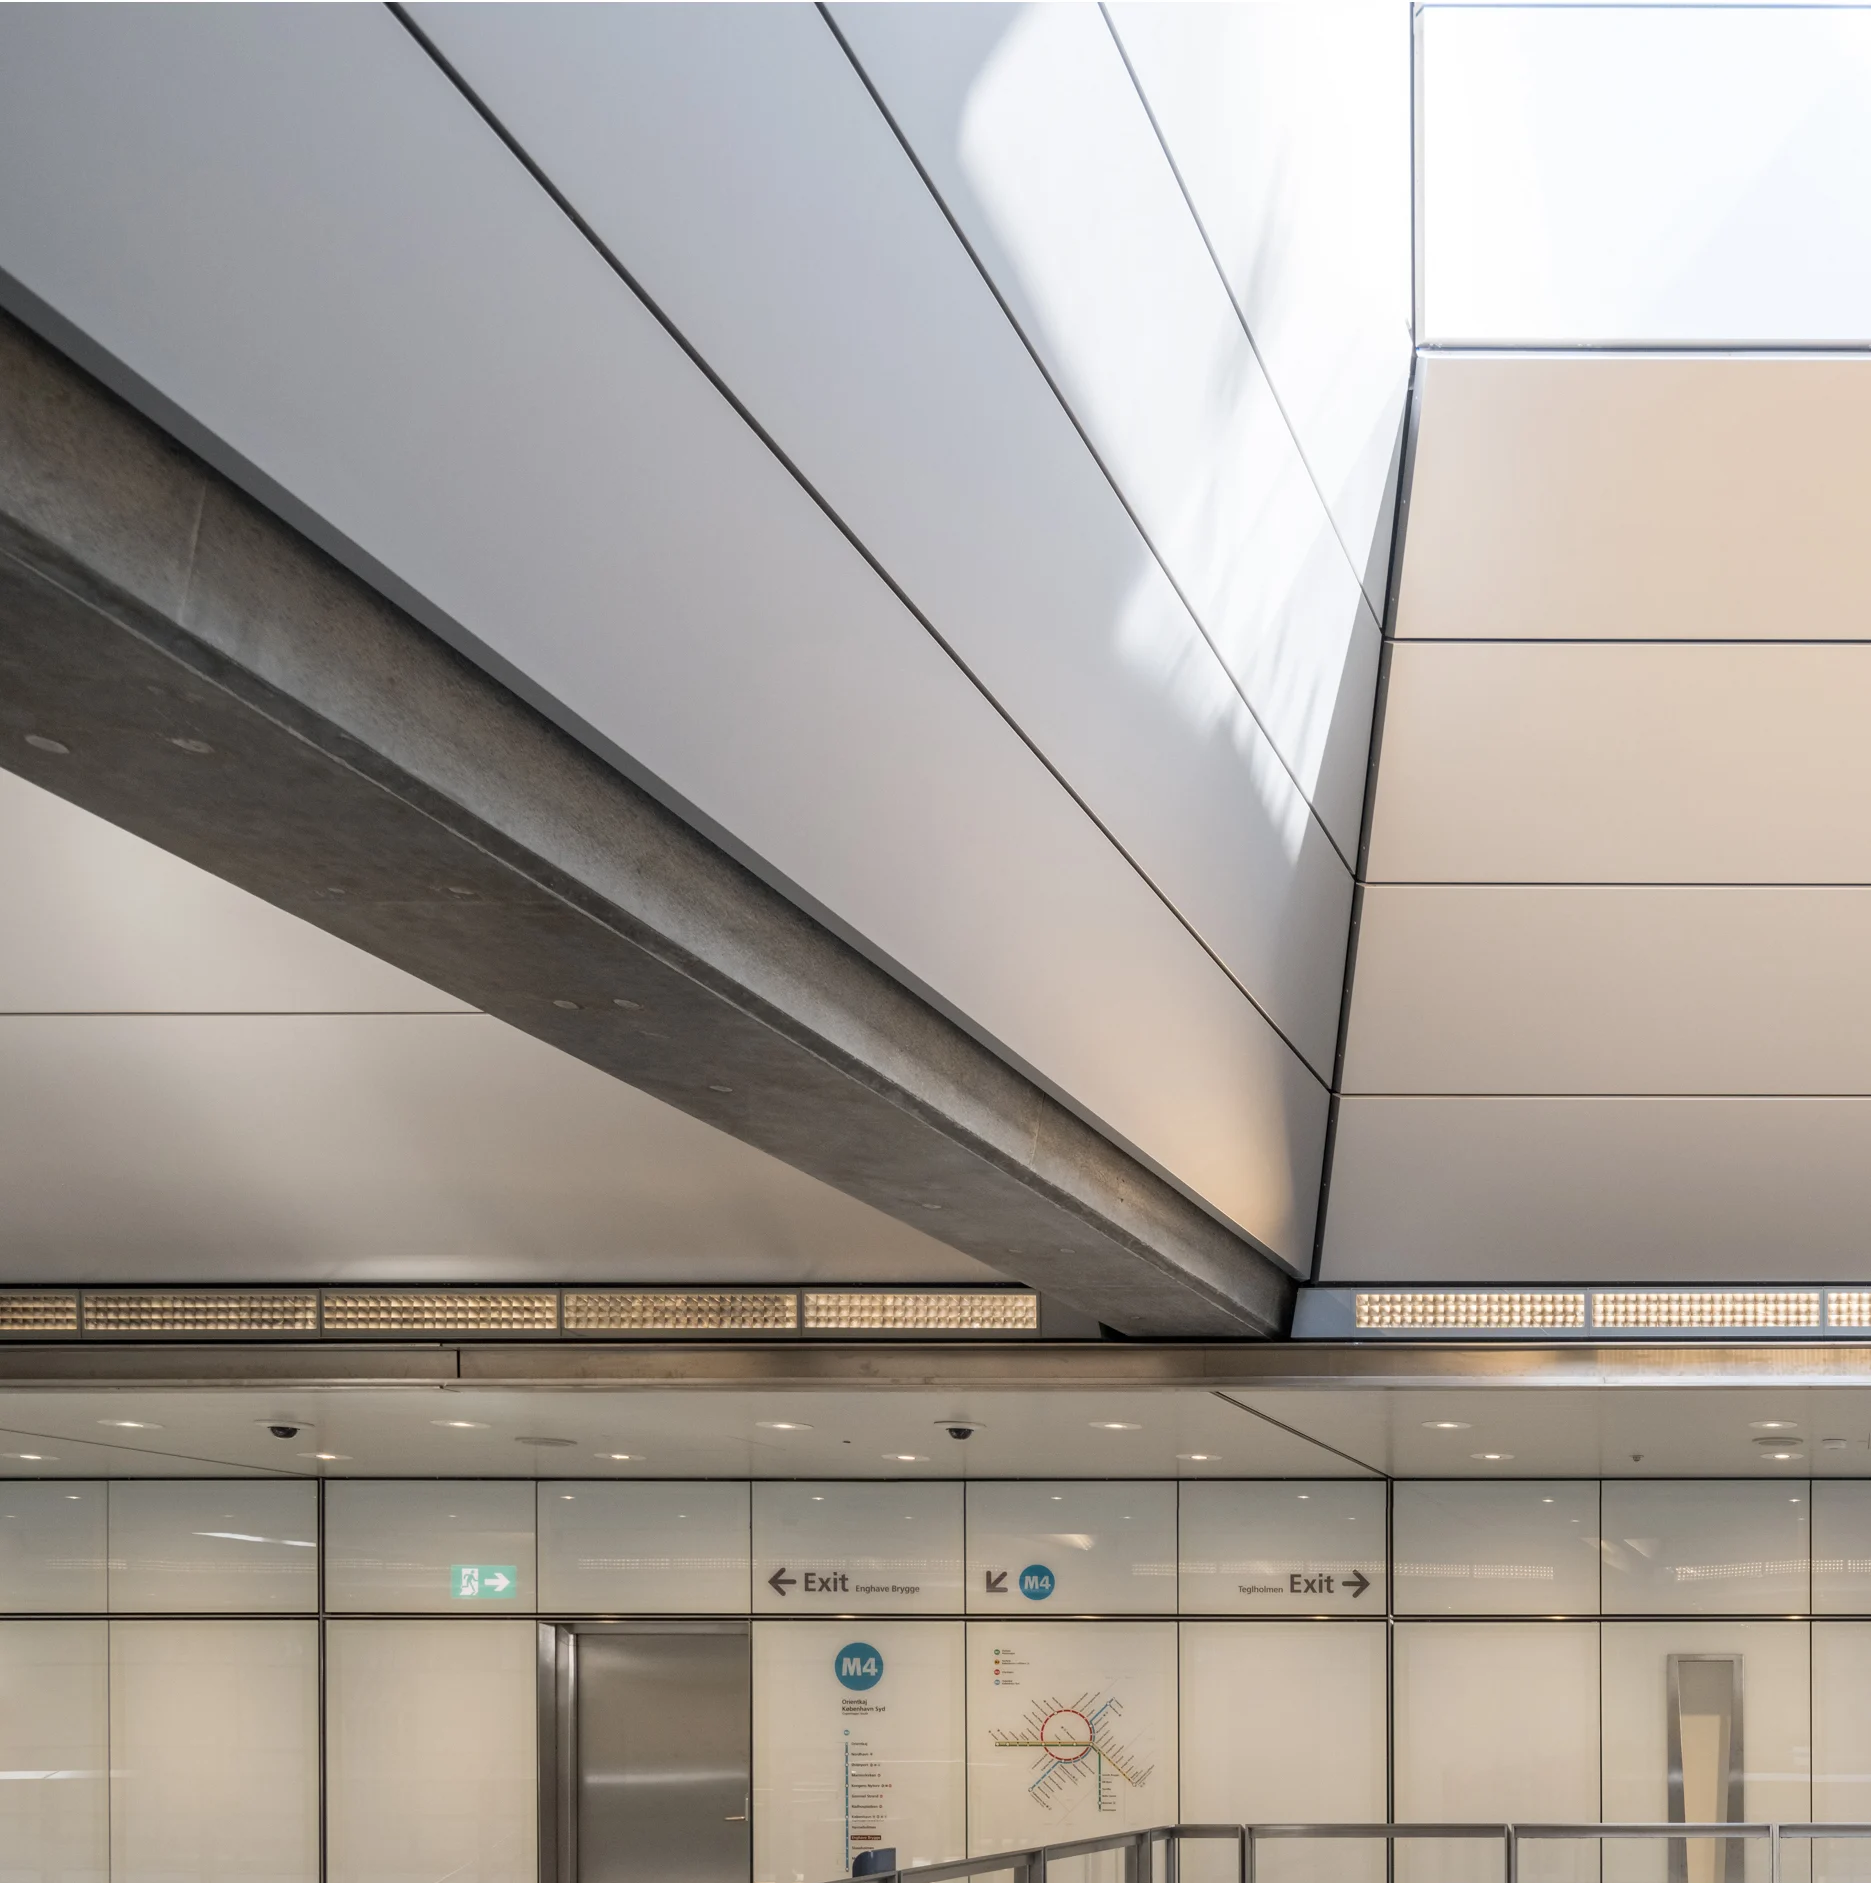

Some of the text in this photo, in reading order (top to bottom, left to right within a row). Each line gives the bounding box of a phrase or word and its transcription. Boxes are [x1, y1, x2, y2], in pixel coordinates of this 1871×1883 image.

[804, 1571, 920, 1594] Exit Enghave Brygge
[1024, 1575, 1051, 1590] M4
[1238, 1573, 1335, 1595] Teglholmen Exit
[841, 1657, 879, 1676] M4
